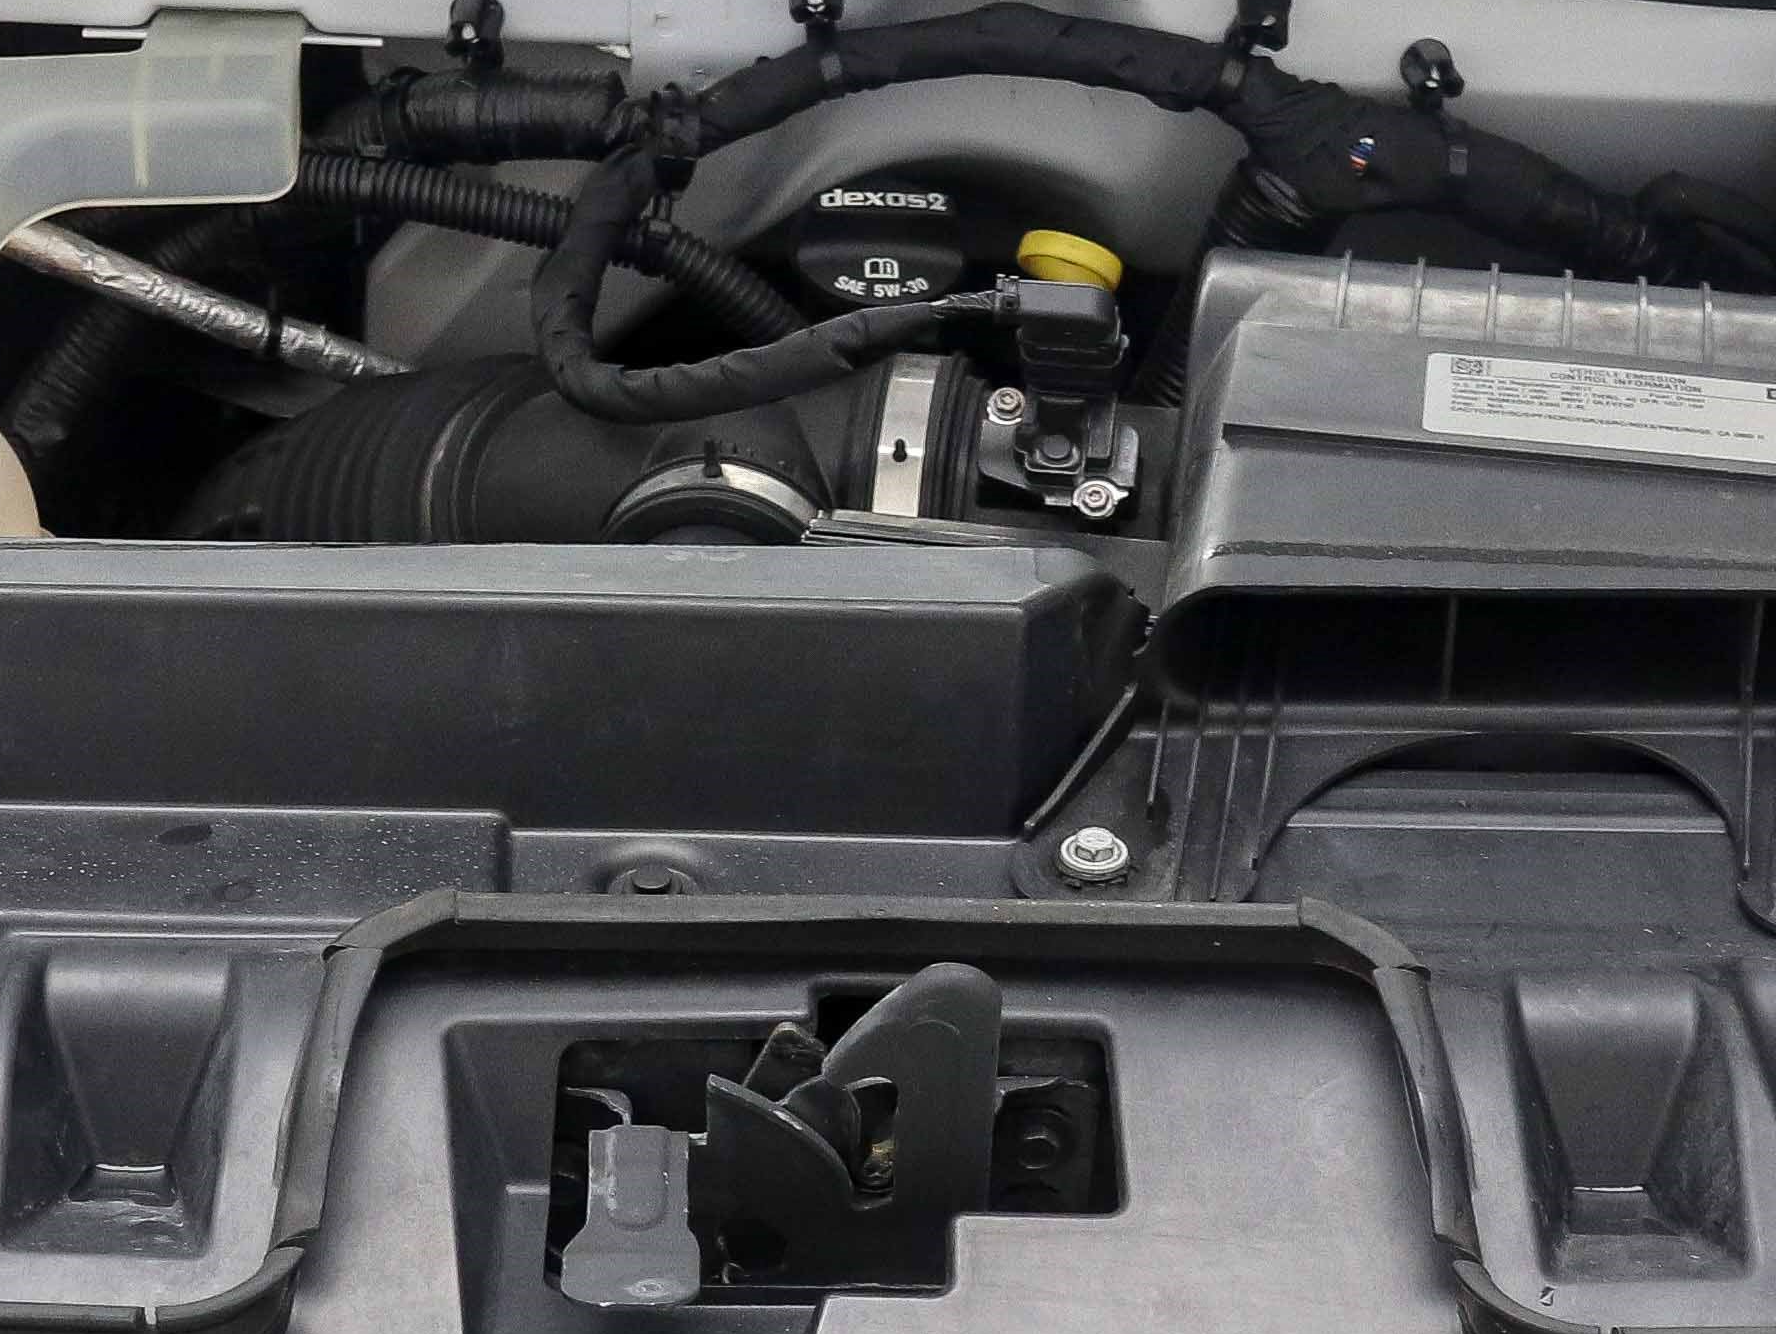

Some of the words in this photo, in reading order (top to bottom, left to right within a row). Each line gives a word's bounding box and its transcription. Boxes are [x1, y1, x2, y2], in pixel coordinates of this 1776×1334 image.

[820, 187, 948, 212] dexos2
[834, 275, 867, 296] SAE
[873, 277, 930, 298] 5W-30
[1549, 372, 1607, 385] CONTROL
[1614, 378, 1702, 394] INFORMATION
